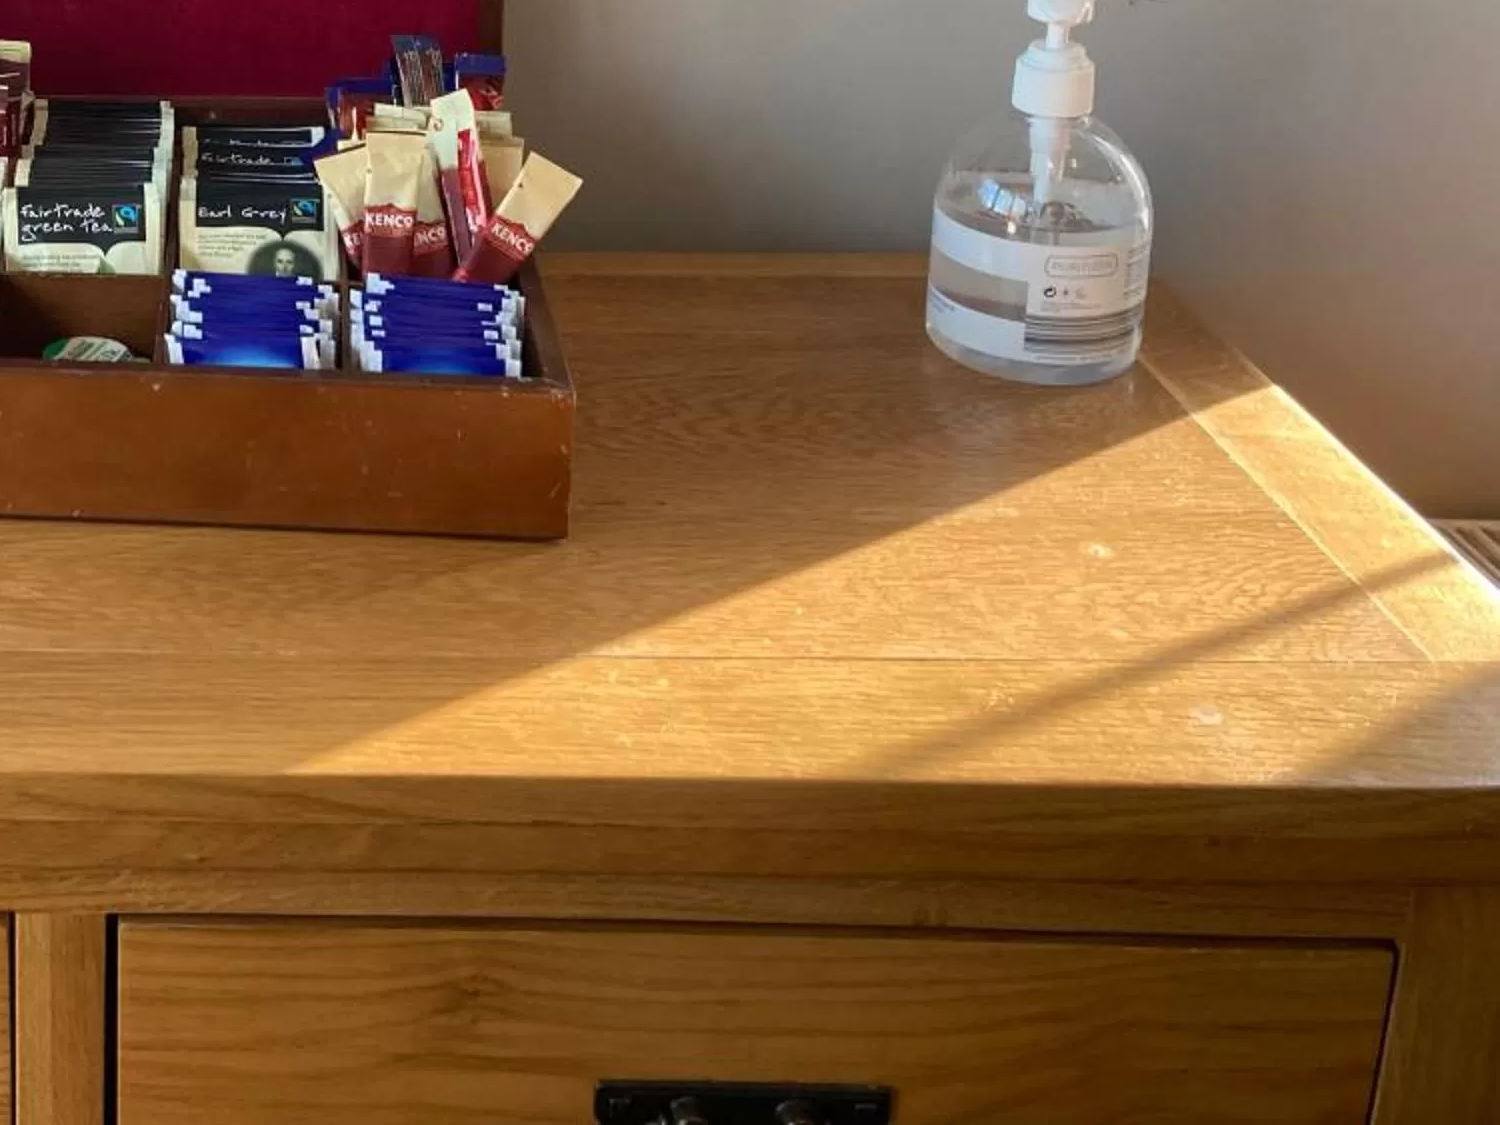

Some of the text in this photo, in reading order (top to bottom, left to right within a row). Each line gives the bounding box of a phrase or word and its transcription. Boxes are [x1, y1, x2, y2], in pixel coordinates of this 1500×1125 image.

[197, 204, 287, 225] Earl Grey
[365, 212, 414, 228] KENCO
[20, 222, 74, 242] green
[491, 223, 534, 252] KENCO
